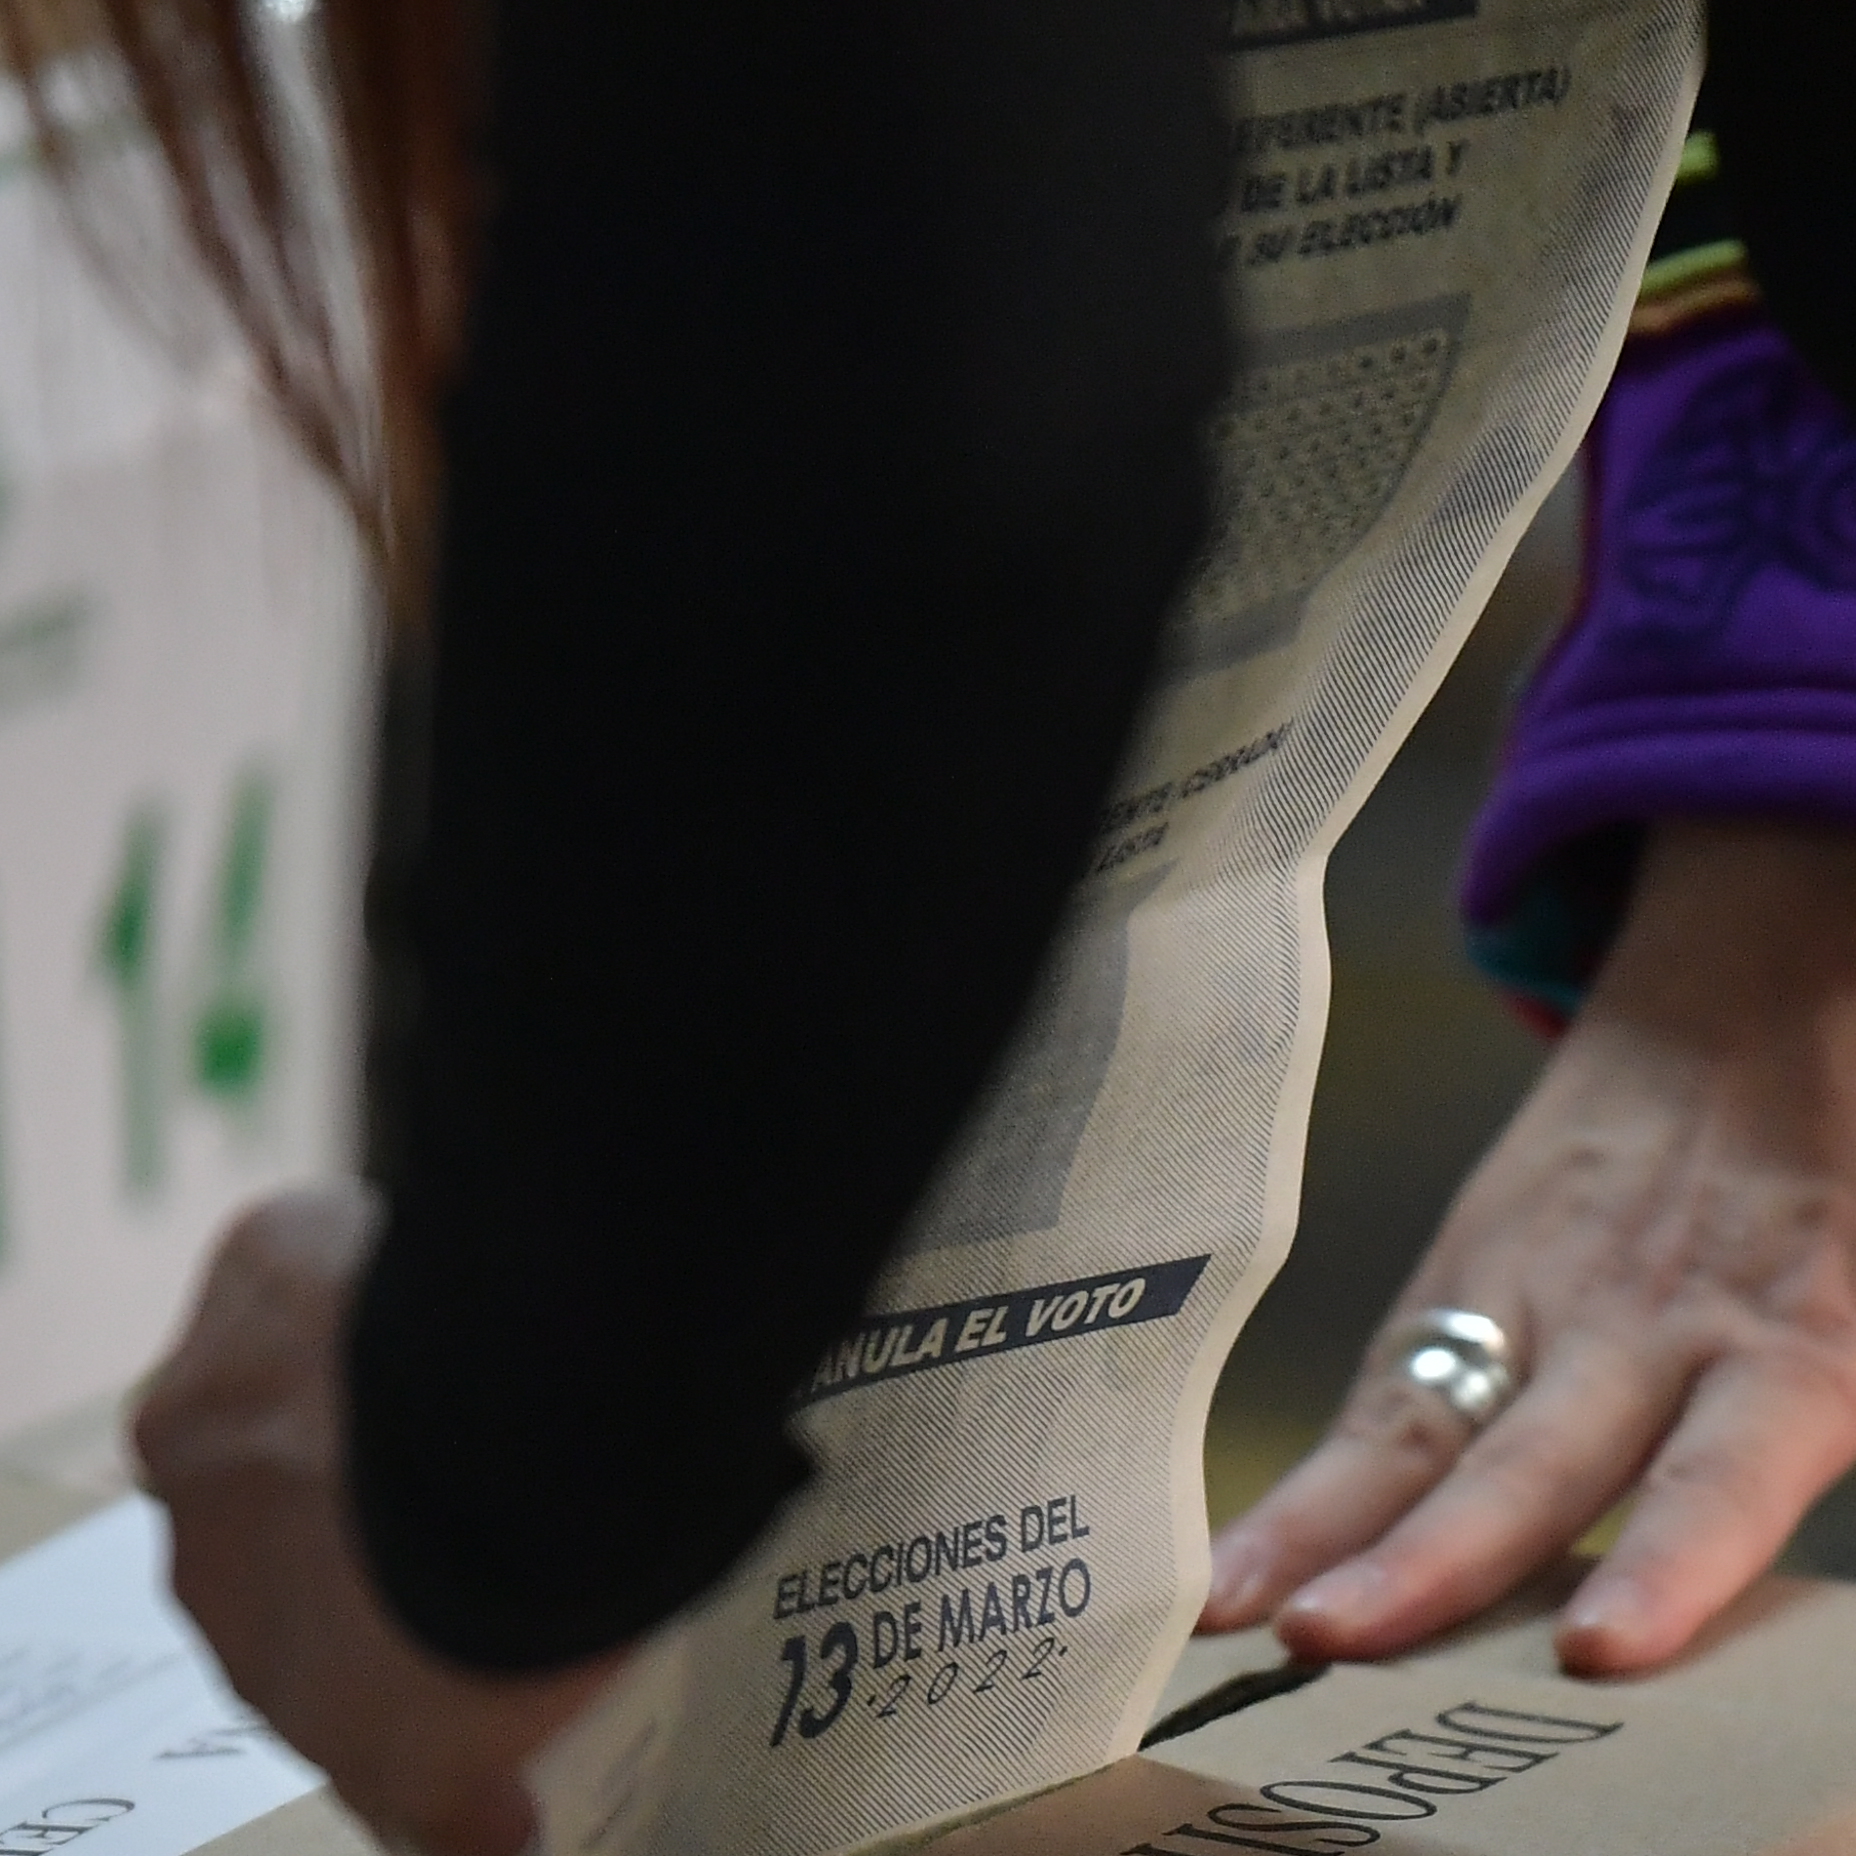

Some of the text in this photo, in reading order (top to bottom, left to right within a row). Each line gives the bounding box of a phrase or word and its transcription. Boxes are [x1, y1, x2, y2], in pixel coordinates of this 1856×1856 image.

[810, 1277, 1147, 1394] ANULA EL VOTO
[772, 1494, 1091, 1621] ELECCIONES DEL
[769, 1557, 1092, 1749] 13 DE MARZO
